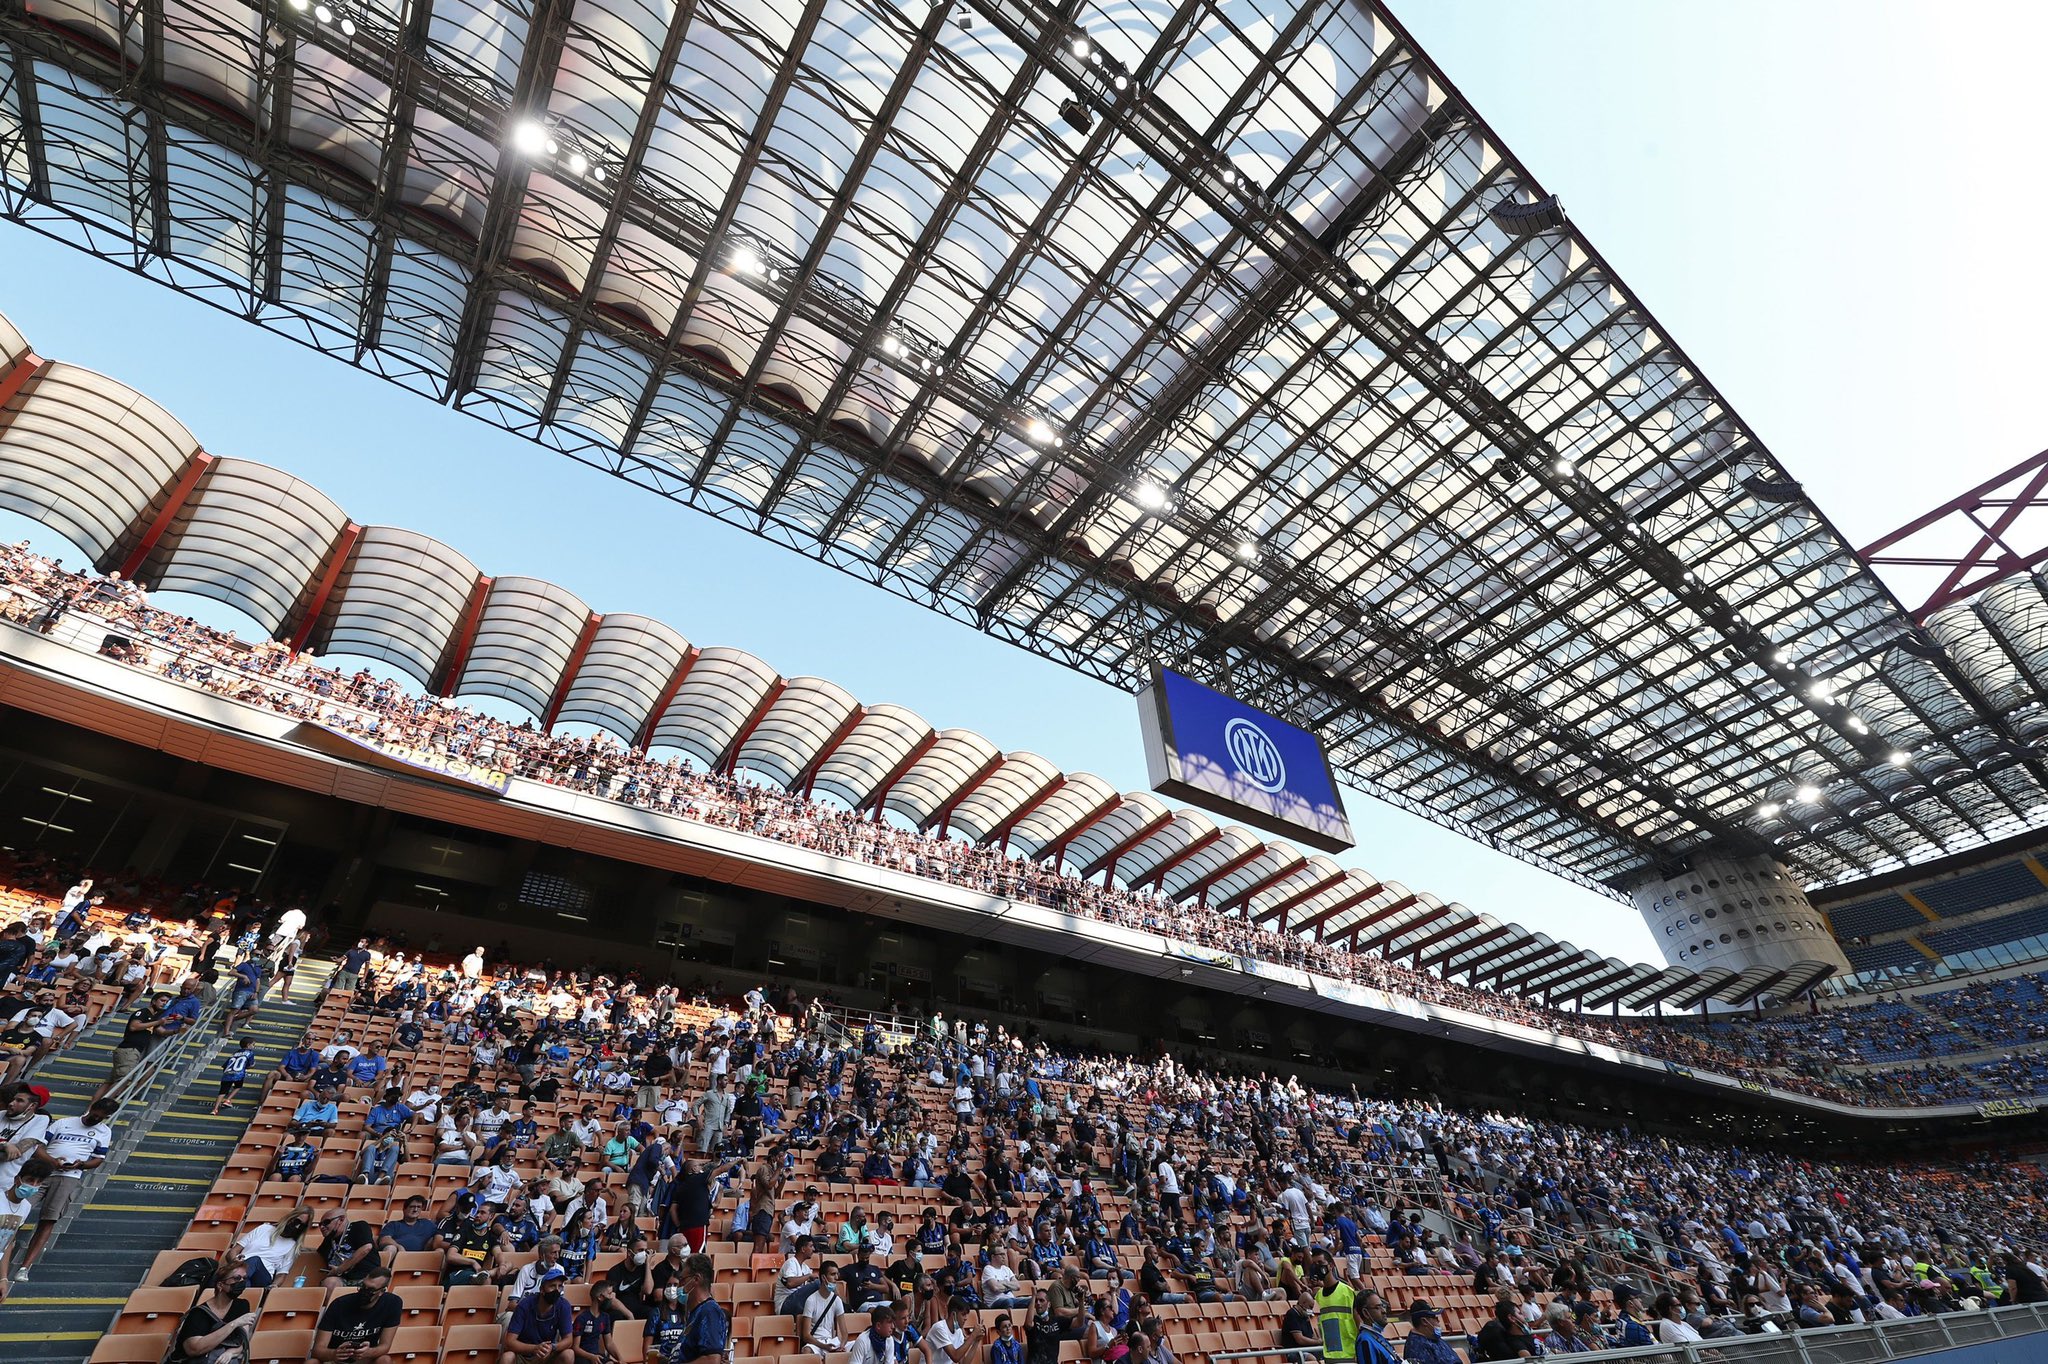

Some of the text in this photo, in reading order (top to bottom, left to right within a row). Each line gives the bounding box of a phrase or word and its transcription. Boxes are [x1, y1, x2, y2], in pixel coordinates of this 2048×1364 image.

[224, 1056, 247, 1072] 20
[1983, 1098, 2023, 1112] MOLE
[169, 1137, 199, 1145] SETTORE
[134, 1183, 168, 1191] SETTORE
[333, 1327, 381, 1338] BURBLE
